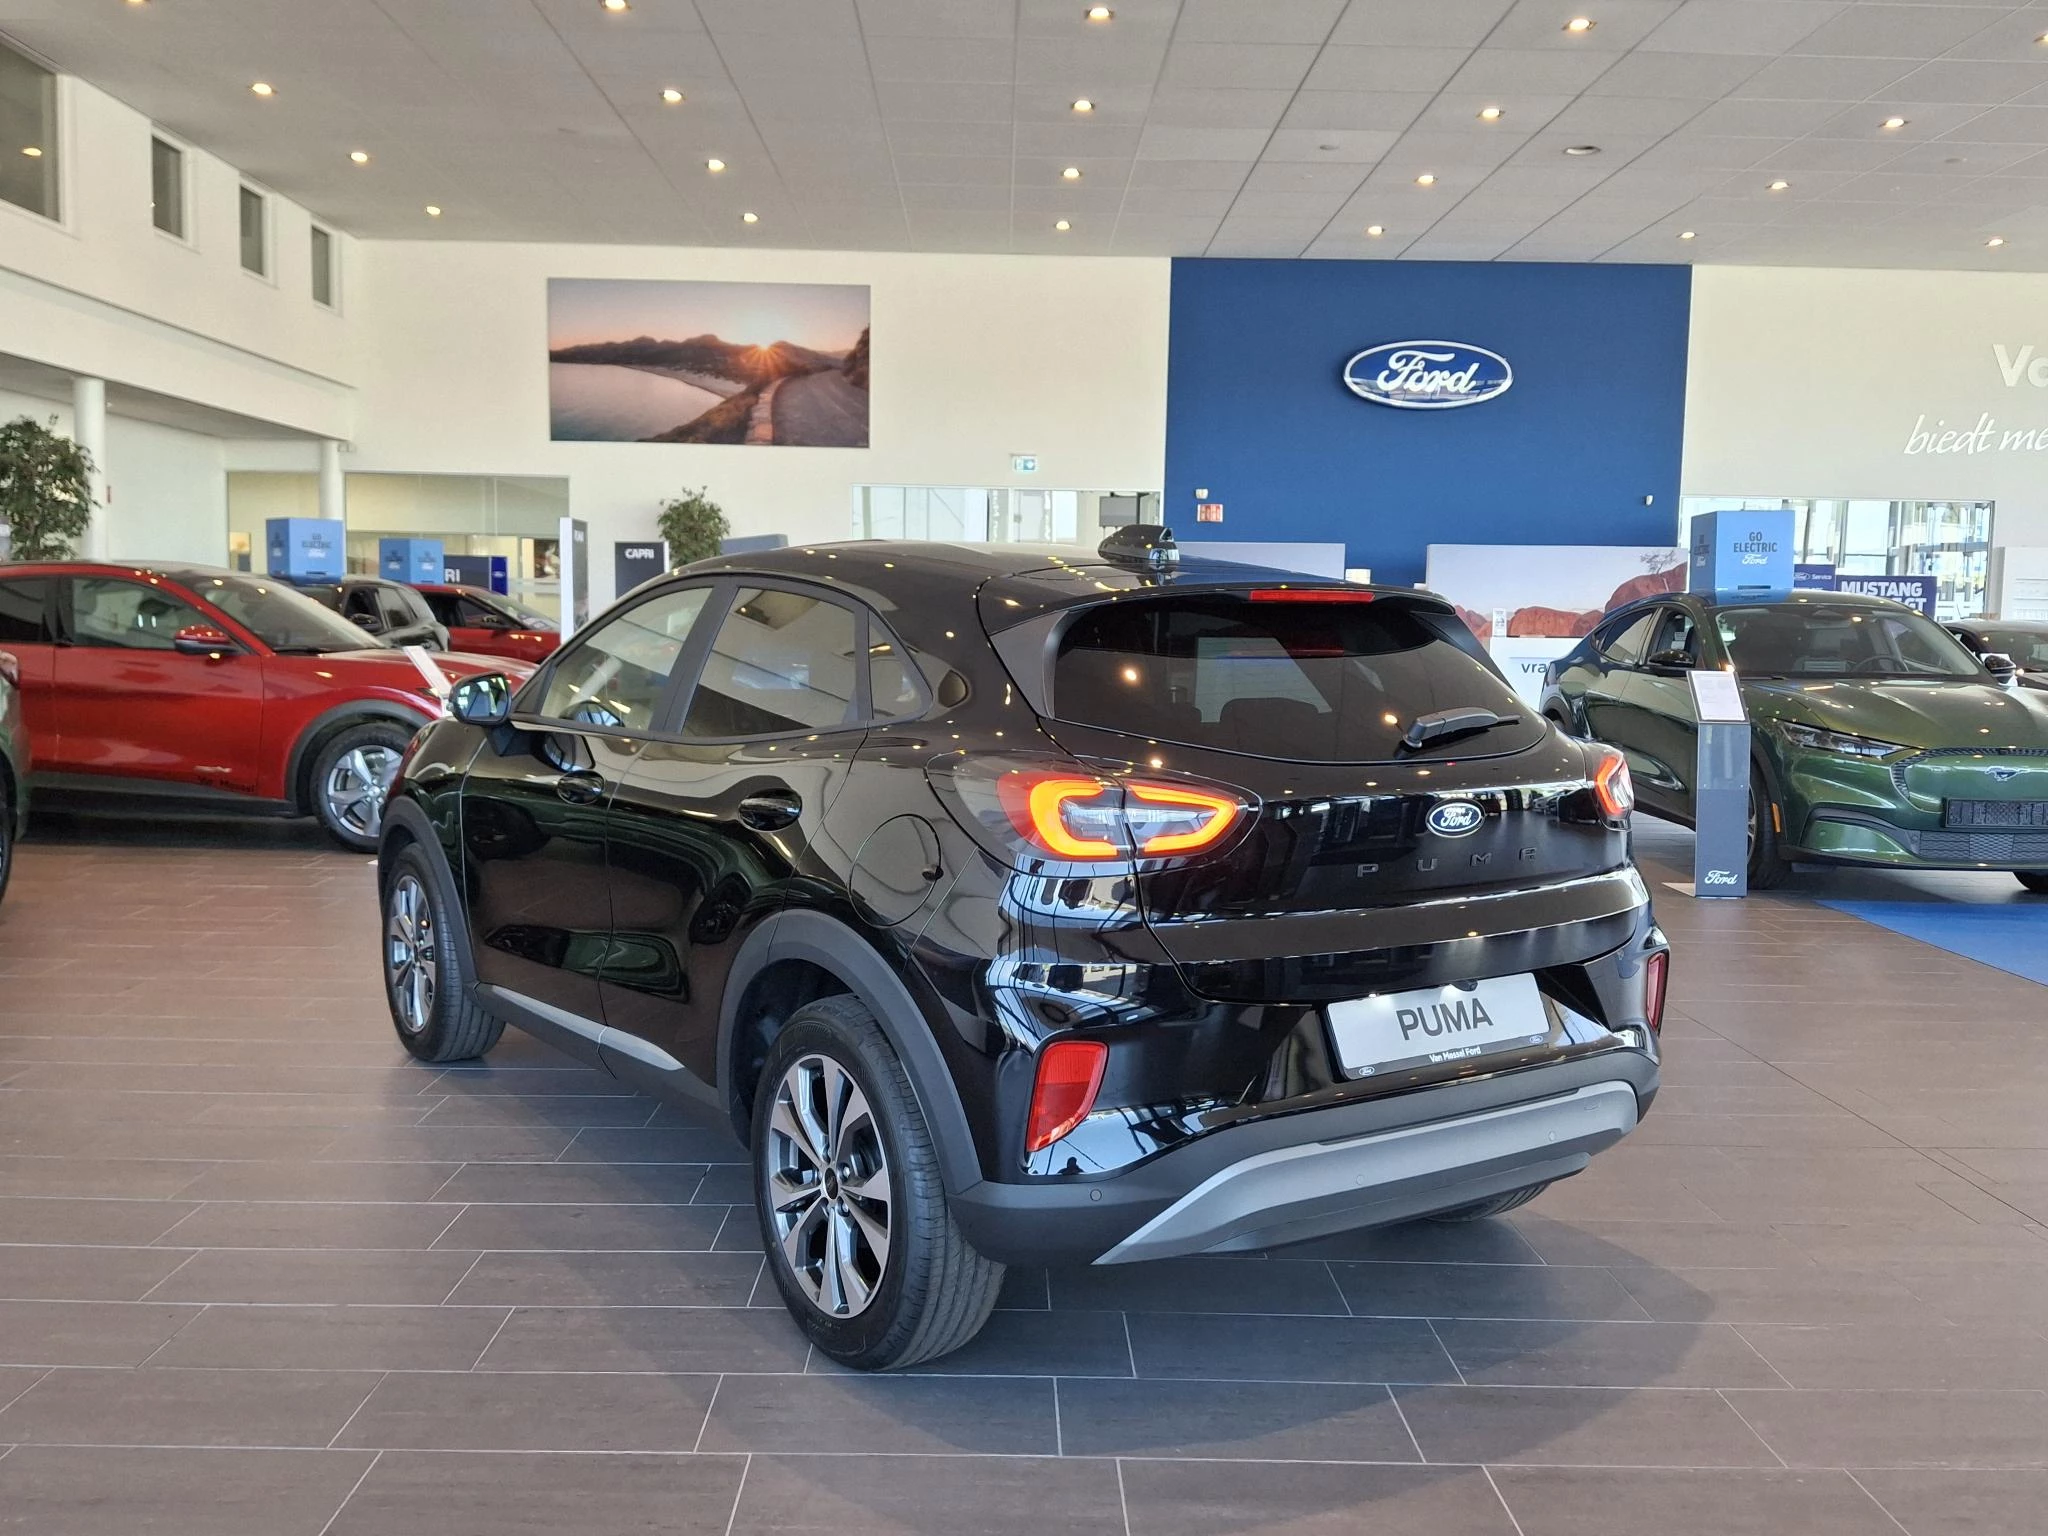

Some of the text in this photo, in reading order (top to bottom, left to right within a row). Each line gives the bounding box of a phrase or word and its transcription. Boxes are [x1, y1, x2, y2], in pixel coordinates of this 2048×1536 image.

[1376, 350, 1480, 394] Ford
[1903, 412, 1996, 455] biedt
[1748, 531, 1763, 542] GO
[625, 548, 655, 560] CAPRI
[1733, 542, 1778, 553] ELECTRIC
[1742, 553, 1768, 565] Ford
[1841, 581, 1923, 597] MUSTANG
[1440, 806, 1473, 827] Ford
[1704, 870, 1738, 885] Ford
[1396, 998, 1494, 1041] PUMA
[1428, 1053, 1443, 1063] Van
[1465, 1046, 1482, 1057] Ford
